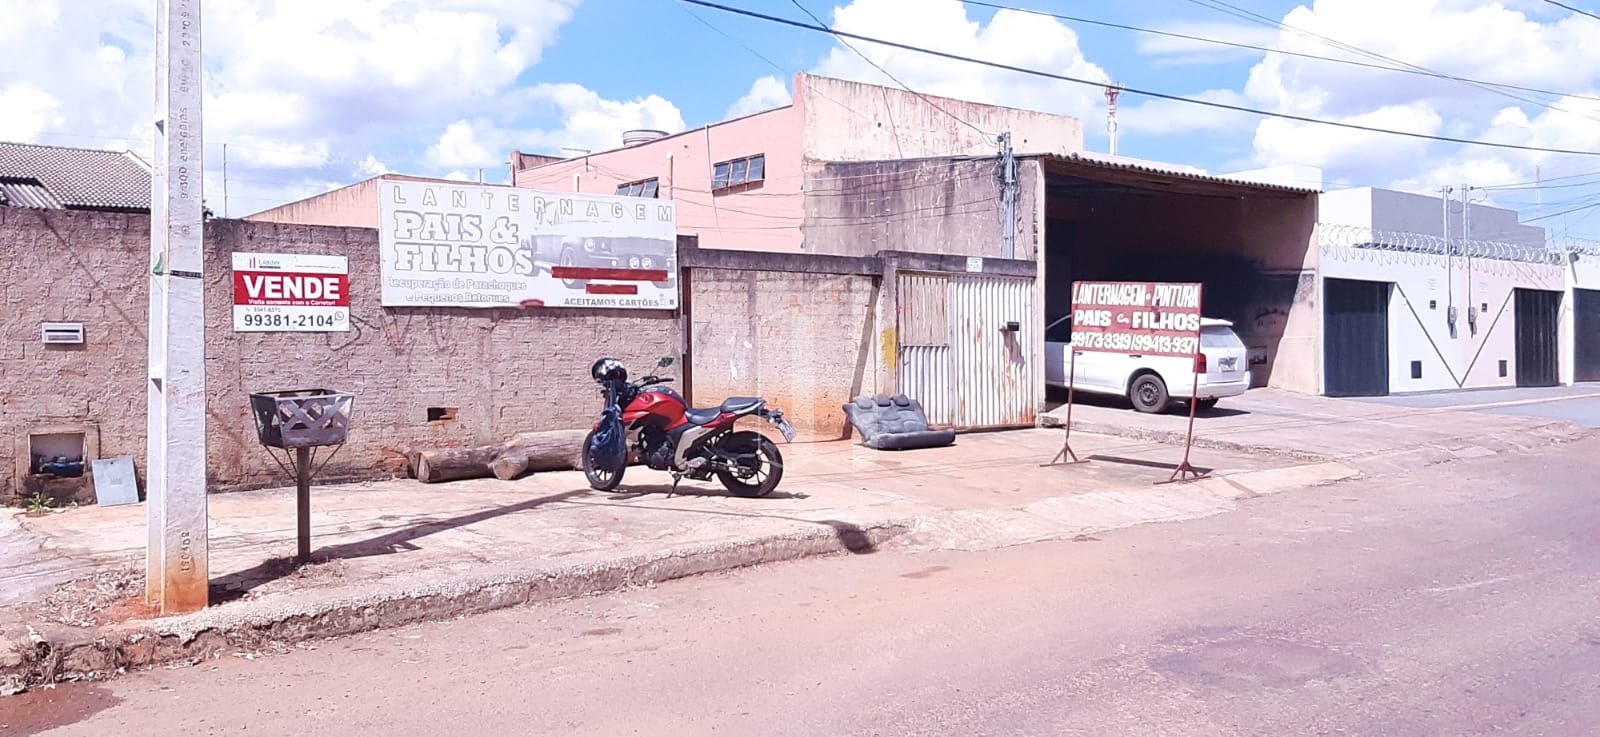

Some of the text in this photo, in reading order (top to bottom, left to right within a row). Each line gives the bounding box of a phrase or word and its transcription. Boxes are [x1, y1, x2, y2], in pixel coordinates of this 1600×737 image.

[393, 185, 673, 222] LANTERNAGEM
[394, 210, 520, 244] PAIS &
[394, 242, 534, 277] FILHOS
[242, 275, 341, 299] VENDE
[1071, 284, 1146, 306] LANTERNAGEM
[1151, 285, 1199, 308] PINTURA
[564, 298, 659, 307] ACEITAMOS CARTÕES
[244, 314, 334, 327] 99381-2104
[1073, 310, 1112, 327] PAIS
[1132, 311, 1200, 331] FILHOS
